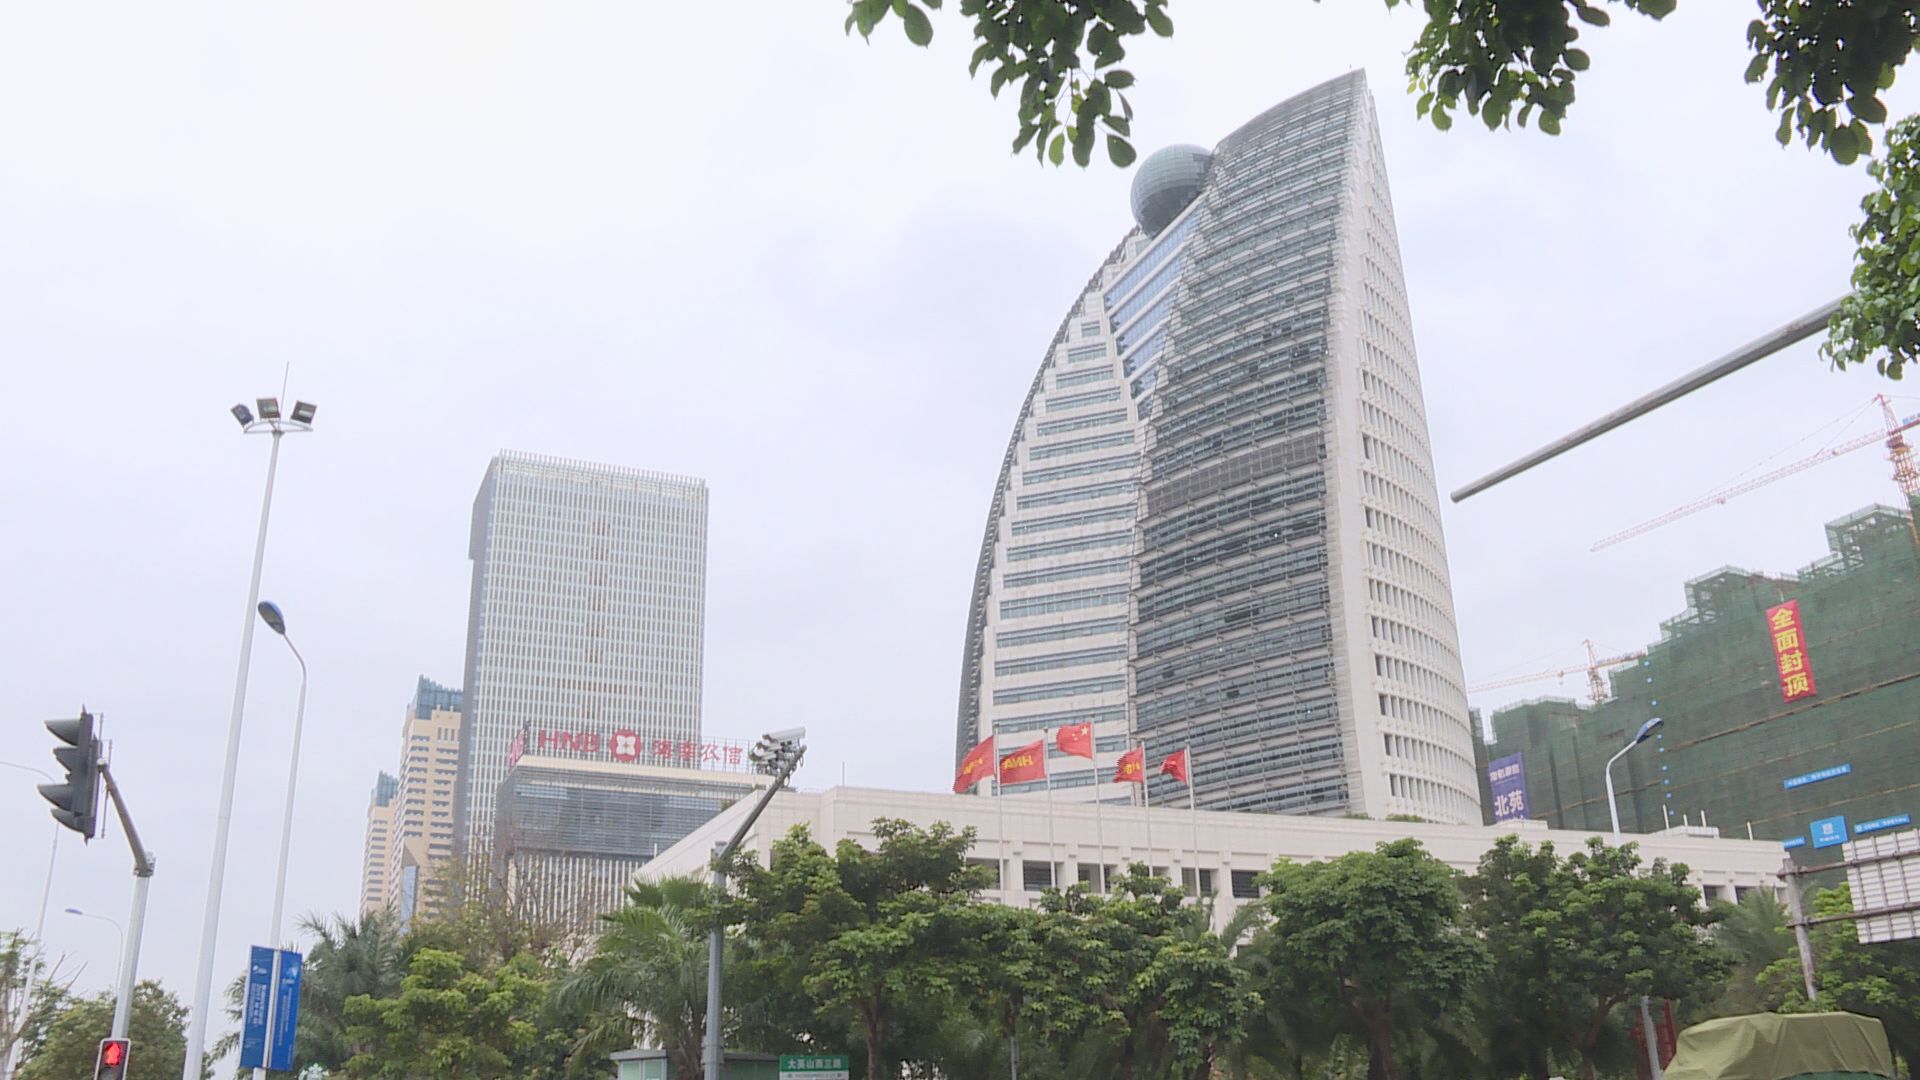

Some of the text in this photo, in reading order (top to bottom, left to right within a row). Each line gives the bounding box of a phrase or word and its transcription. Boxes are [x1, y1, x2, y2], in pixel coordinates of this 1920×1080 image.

[1771, 607, 1809, 697] 全面封顶
[538, 729, 599, 753] HNB
[1494, 788, 1525, 817] 北苑
